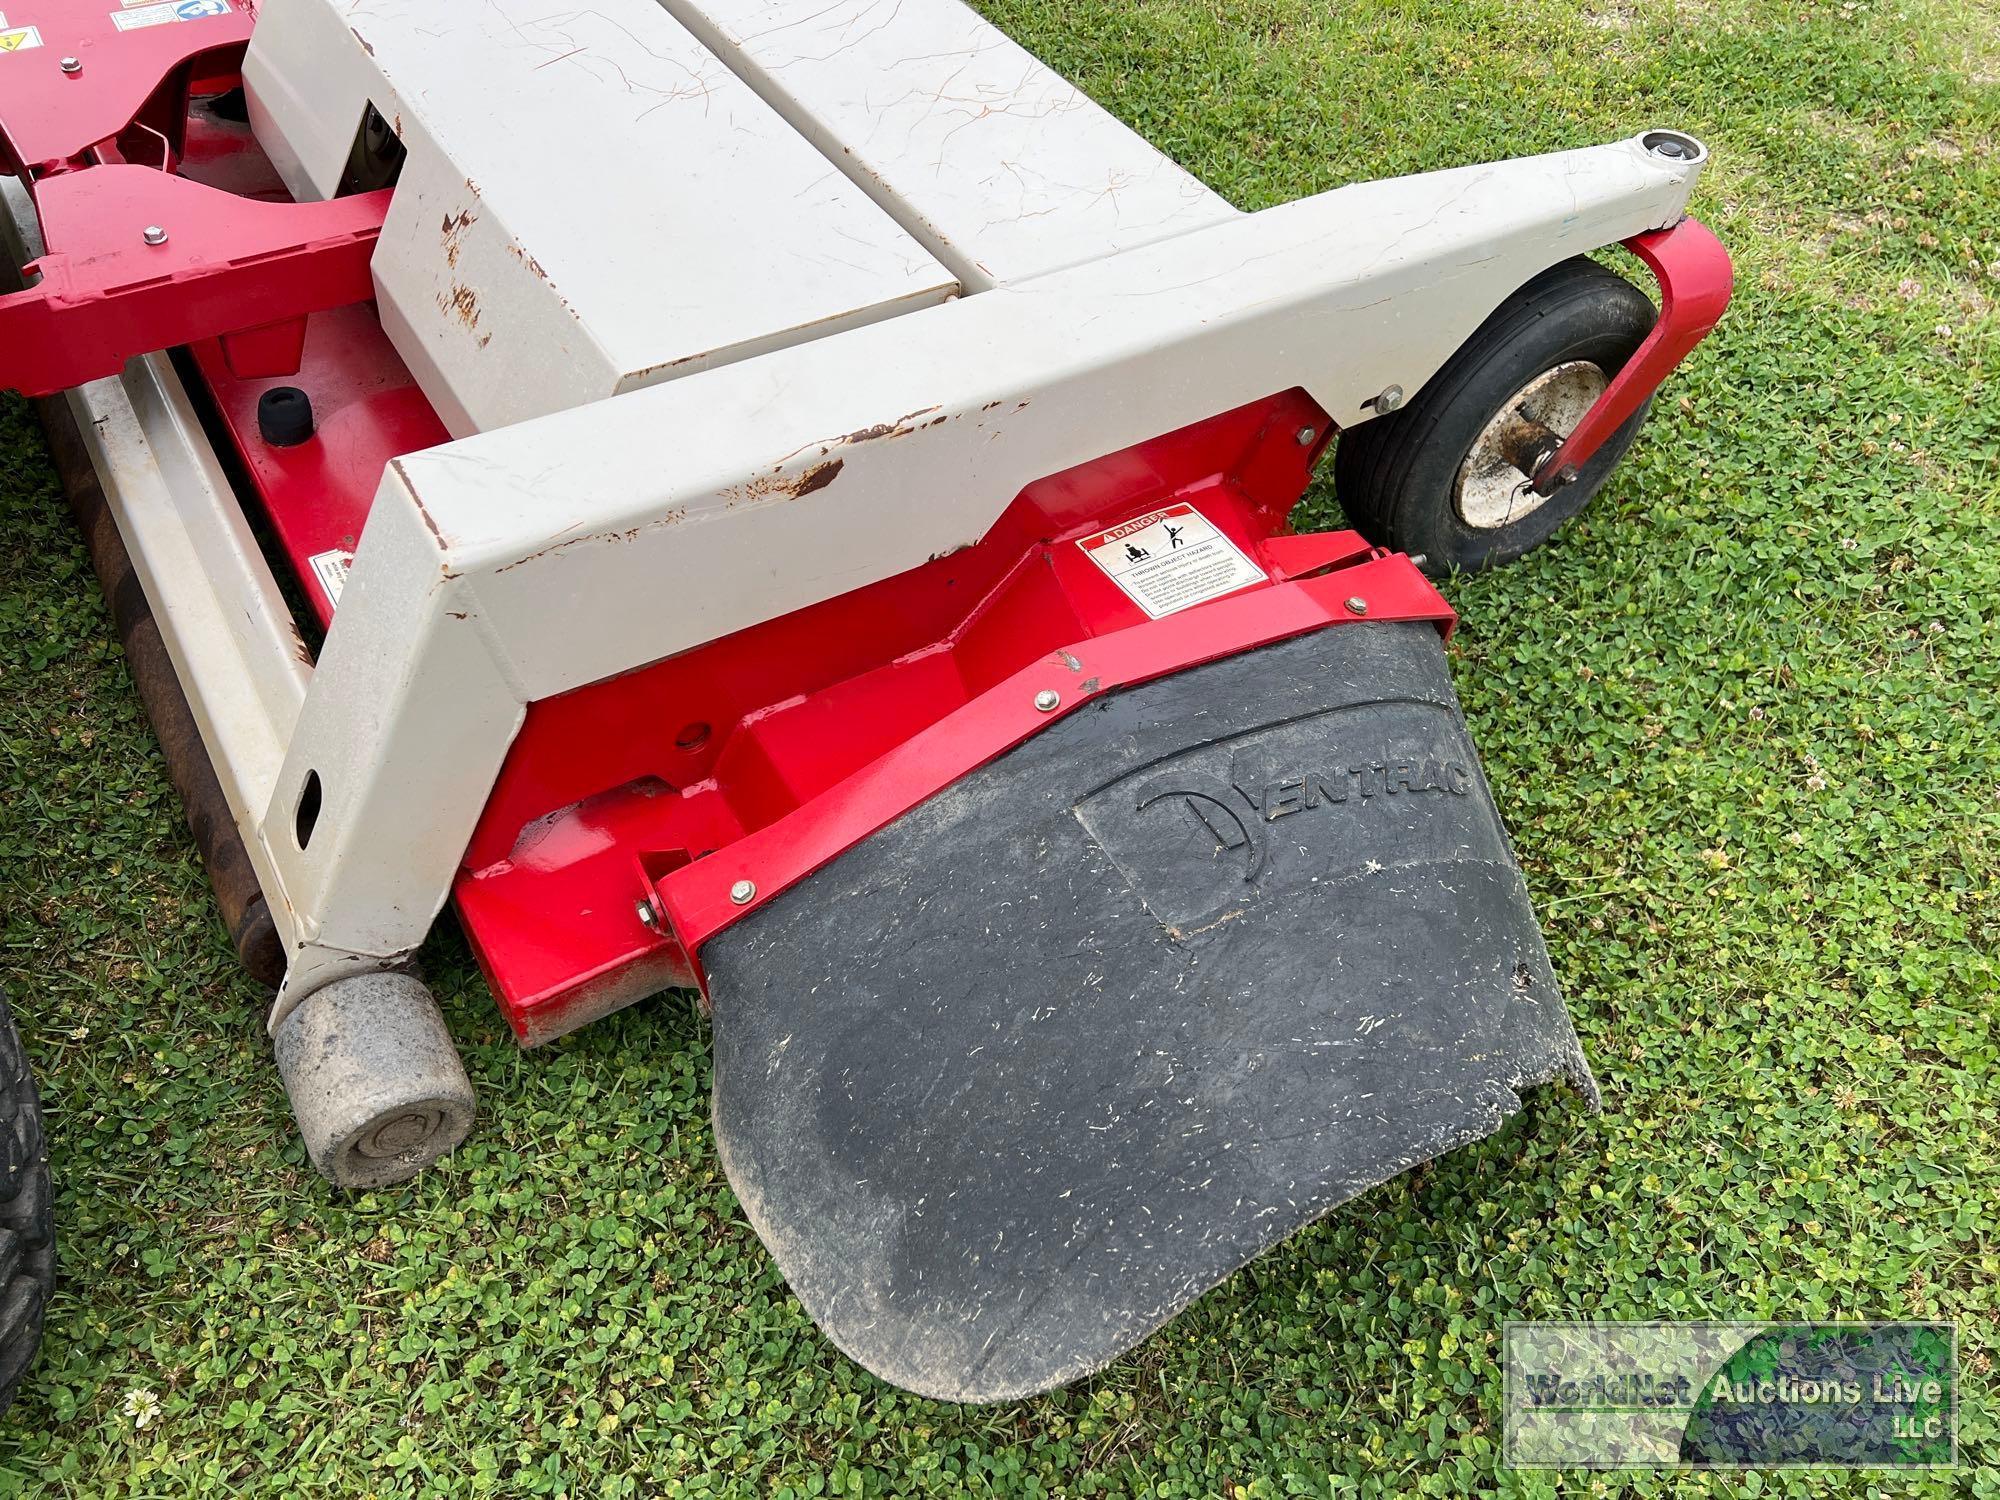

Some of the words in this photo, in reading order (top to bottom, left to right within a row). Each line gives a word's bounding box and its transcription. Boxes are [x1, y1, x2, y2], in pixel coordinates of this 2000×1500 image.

[1113, 512, 1169, 538] DANGER
[1131, 565, 1161, 578] THROWN
[1160, 555, 1187, 567] OBJECT
[1186, 545, 1214, 557] HAZARD
